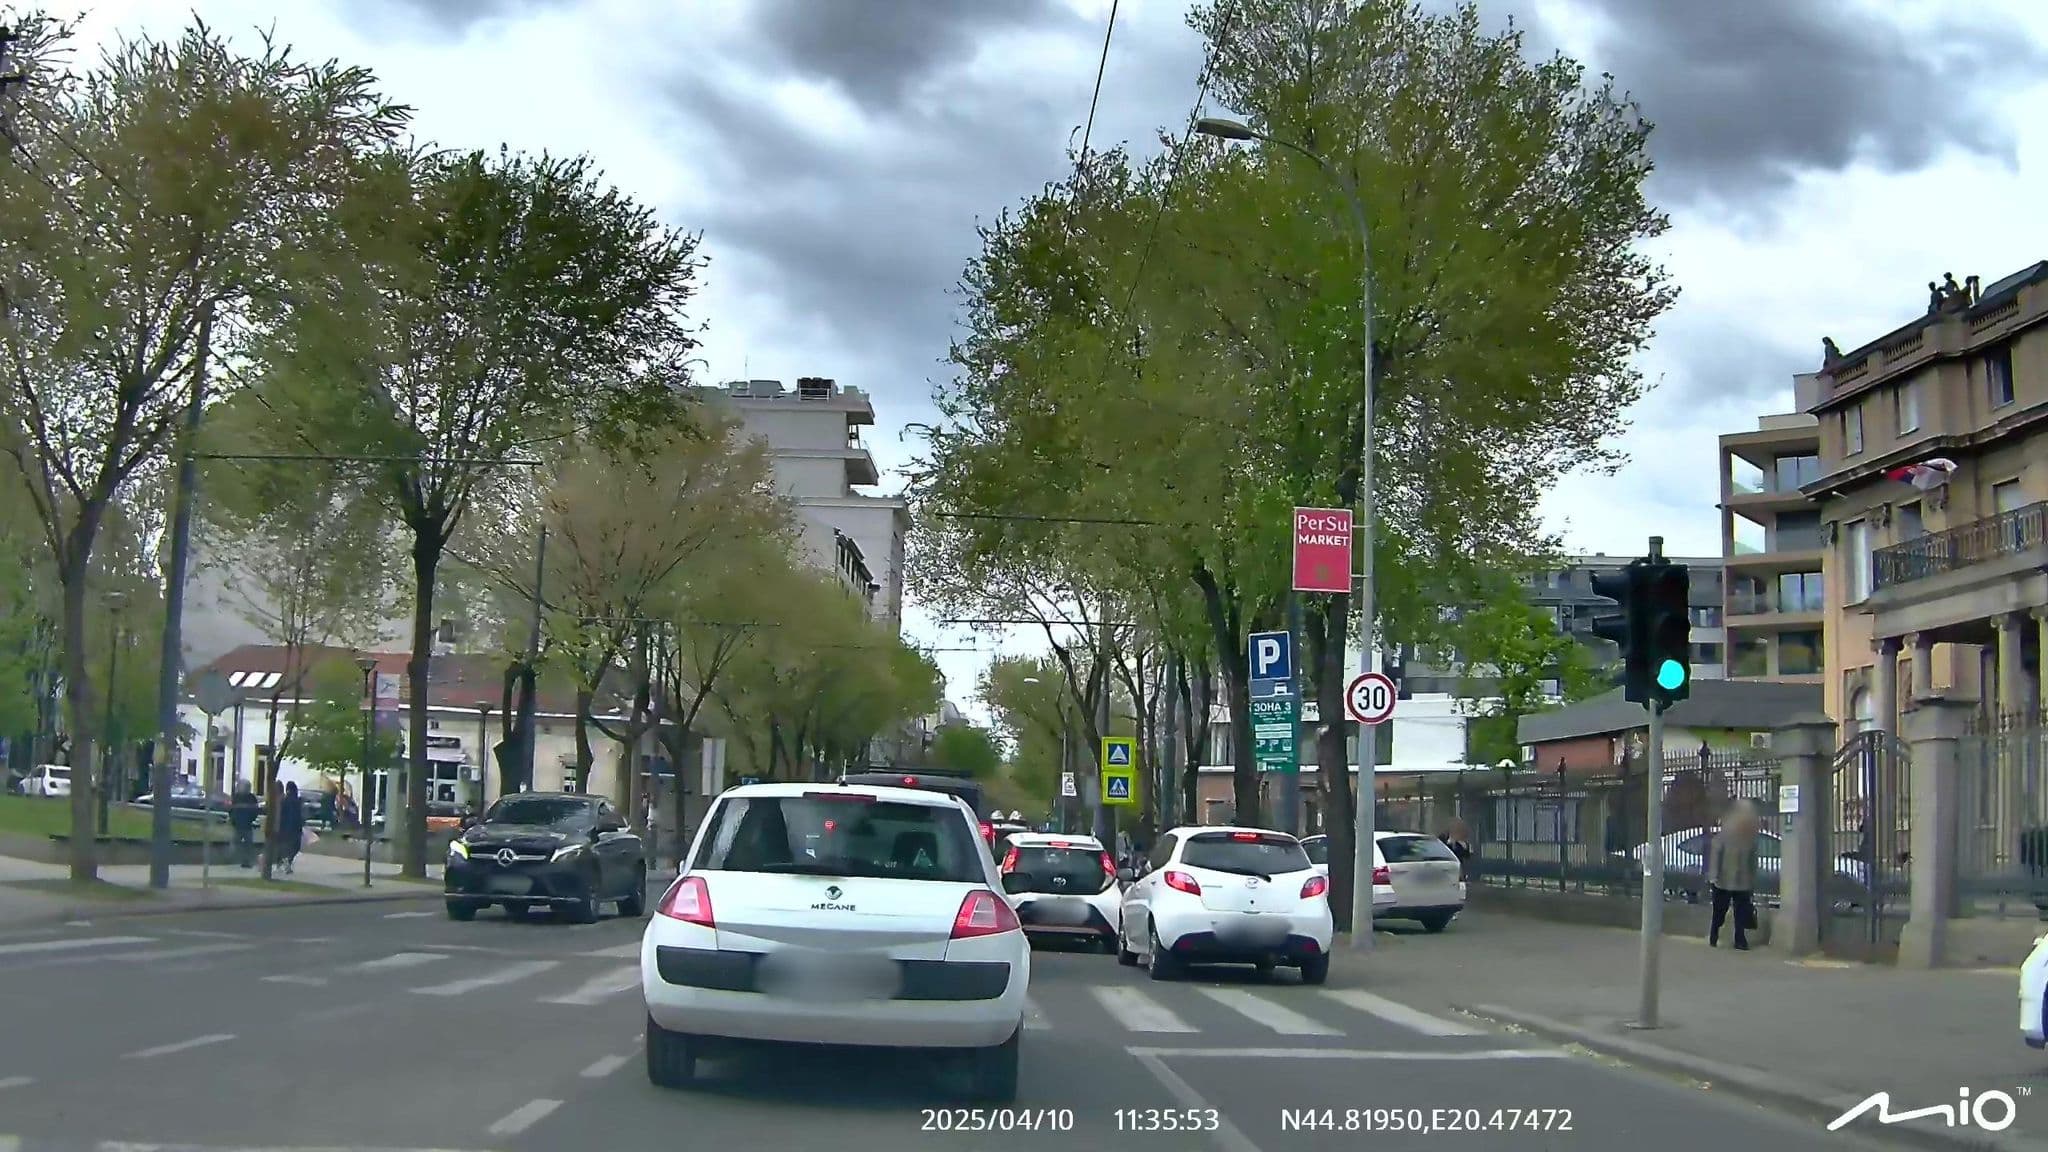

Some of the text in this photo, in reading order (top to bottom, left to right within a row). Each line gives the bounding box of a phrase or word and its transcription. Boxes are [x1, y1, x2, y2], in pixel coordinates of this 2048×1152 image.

[1297, 514, 1349, 532] PerSu
[1298, 534, 1349, 547] MARKET
[1258, 638, 1280, 675] P
[1358, 686, 1386, 710] 30
